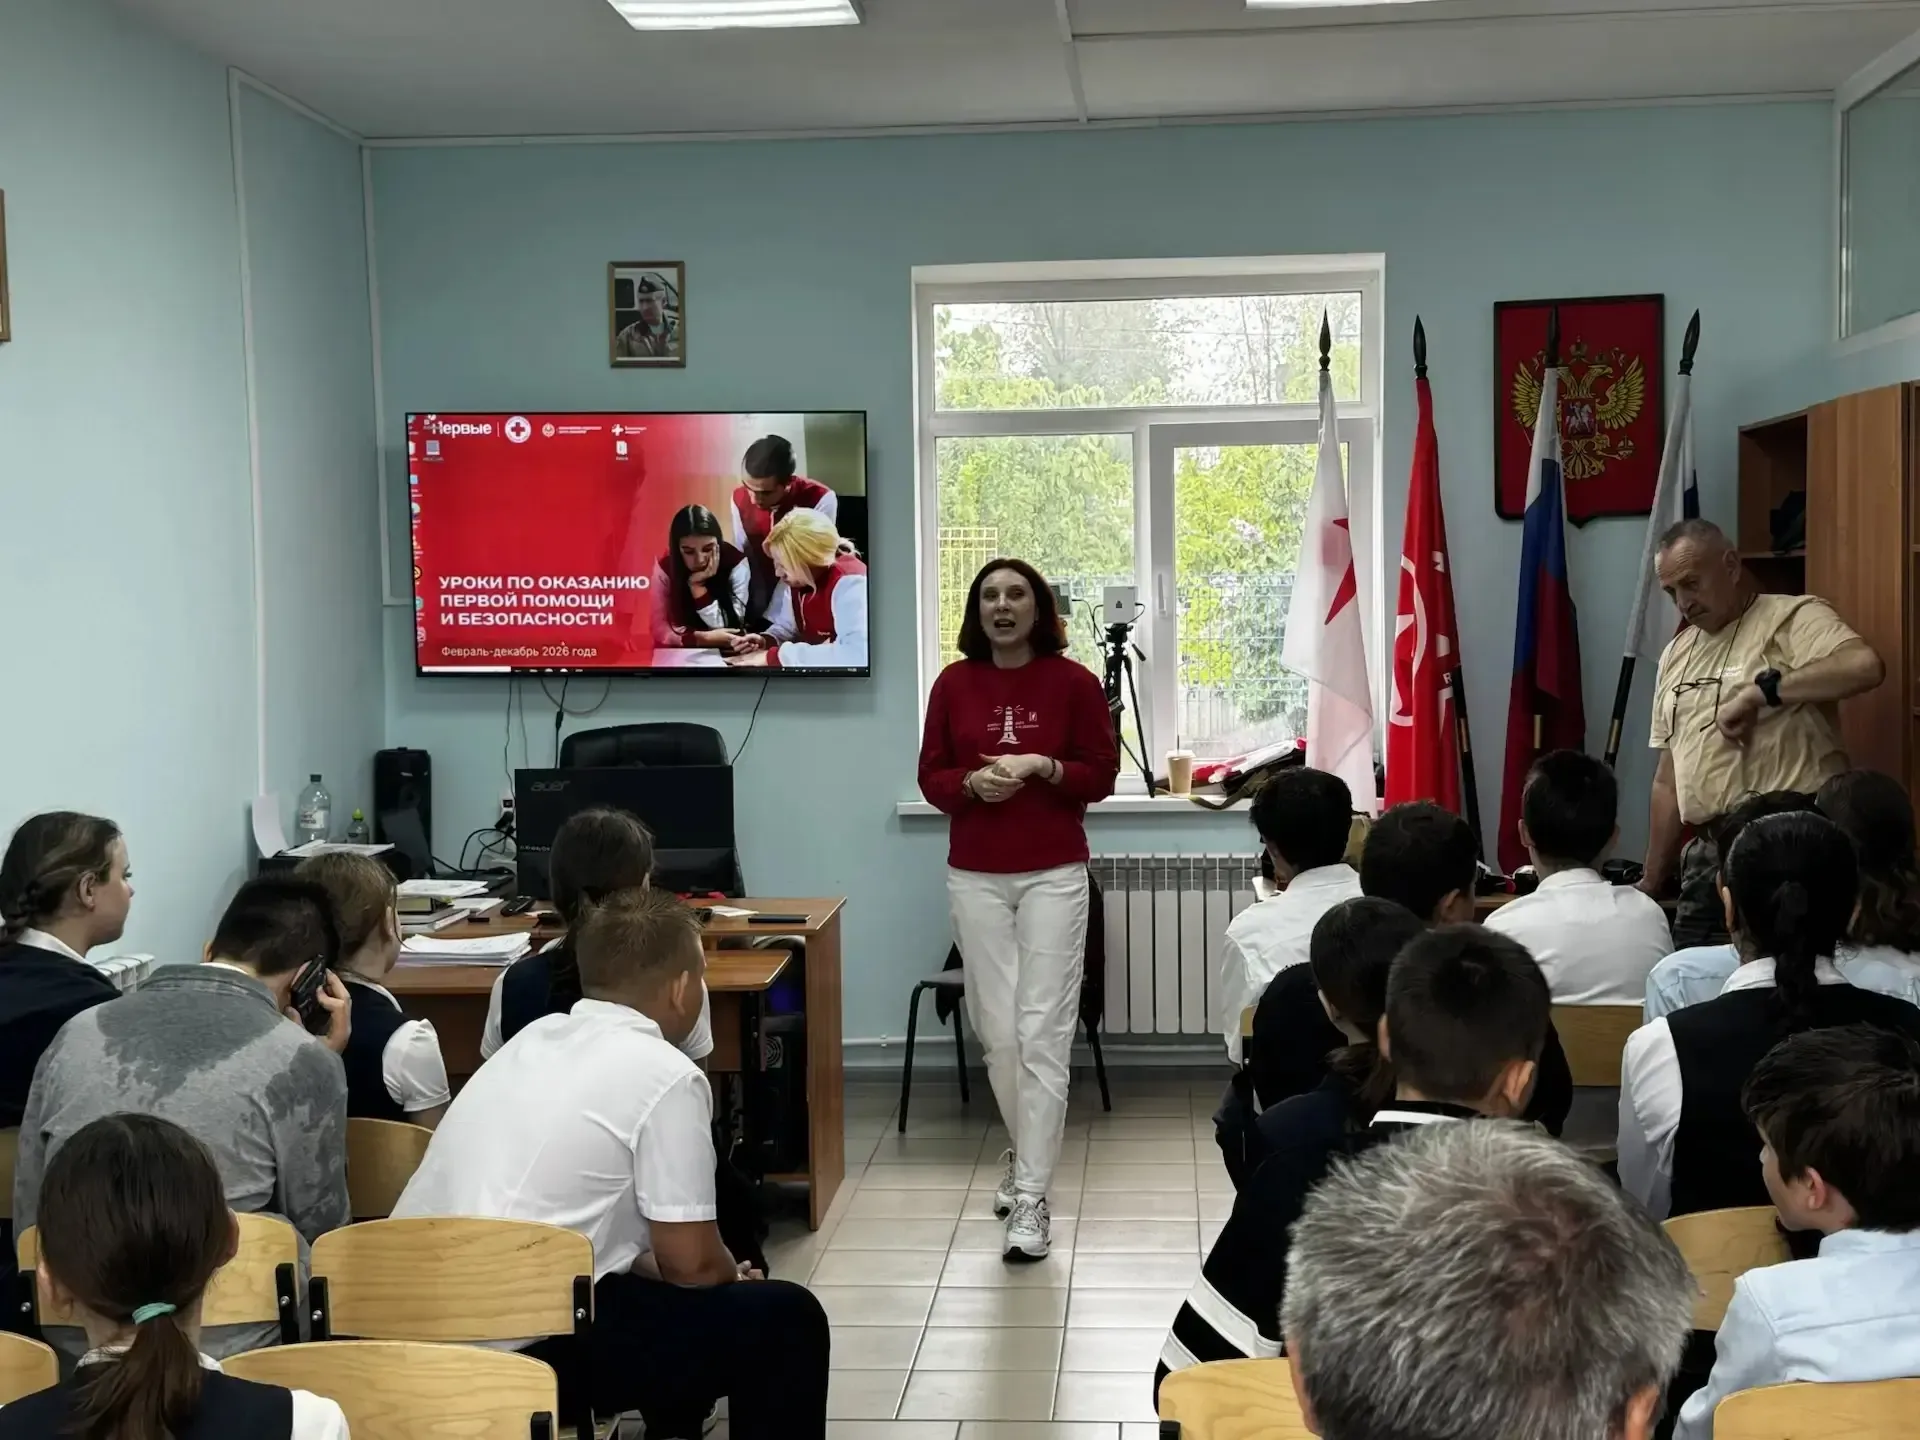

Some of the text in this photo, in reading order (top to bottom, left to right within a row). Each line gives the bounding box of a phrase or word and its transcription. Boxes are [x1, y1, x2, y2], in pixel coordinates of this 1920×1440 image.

[438, 576, 650, 589] УРОКИ ПО ОКАЗАНИЮ
[440, 592, 614, 609] ПЕРВОЙ ПОМОЩИ
[440, 612, 454, 625] И
[458, 612, 613, 625] БЕЗОПАСНОСТИ
[441, 646, 597, 658] Февраль-декабрь 2026 года
[530, 780, 571, 792] acer
